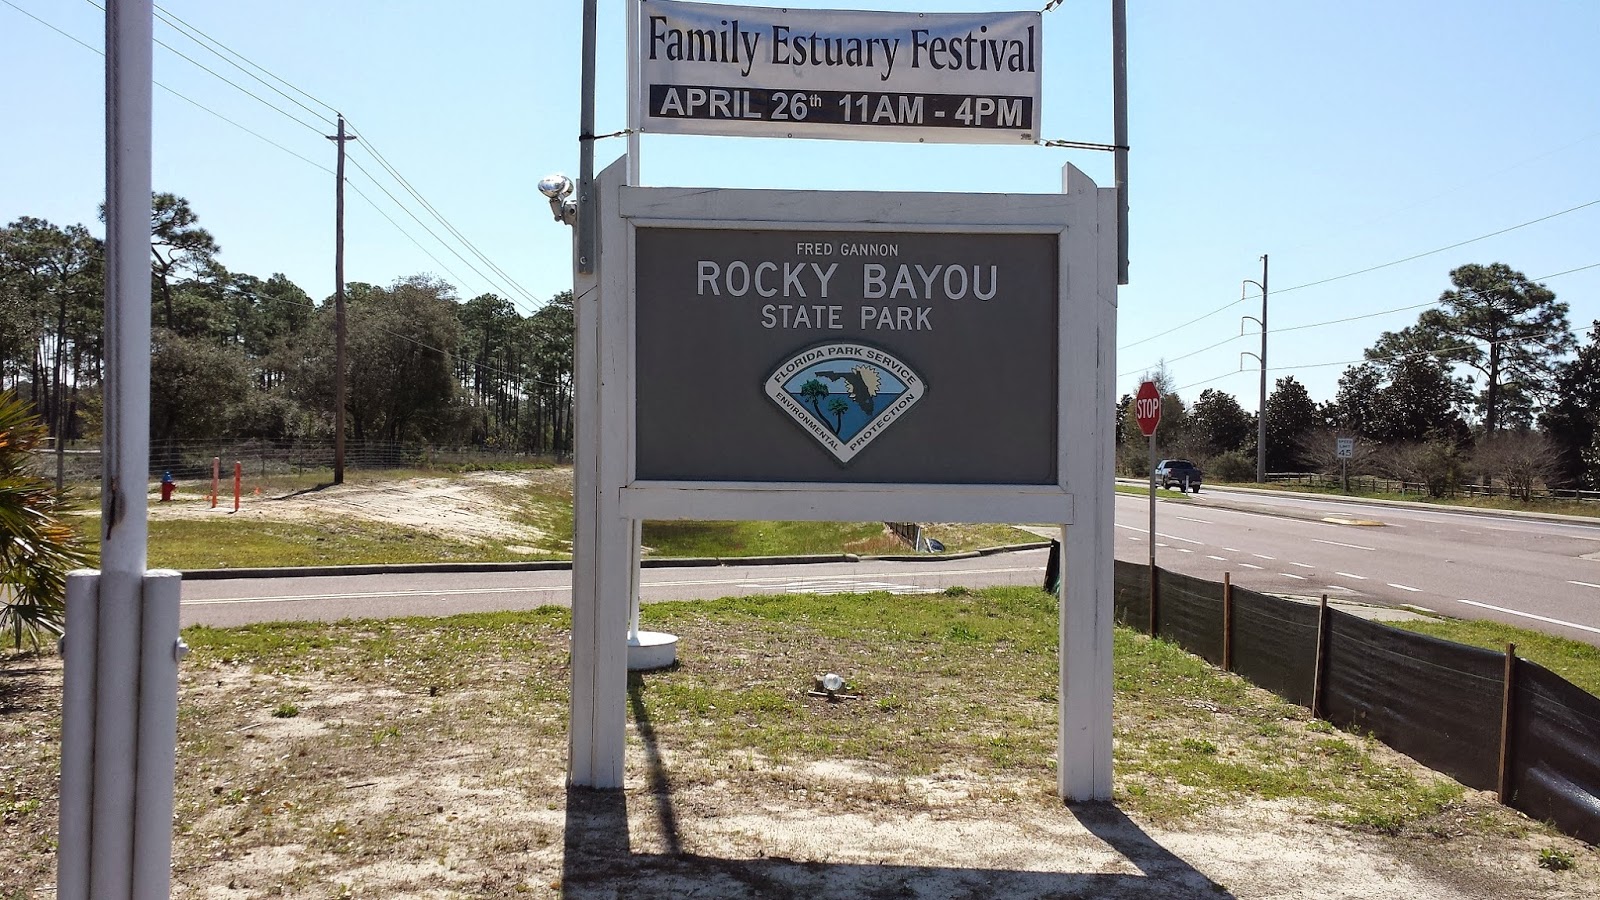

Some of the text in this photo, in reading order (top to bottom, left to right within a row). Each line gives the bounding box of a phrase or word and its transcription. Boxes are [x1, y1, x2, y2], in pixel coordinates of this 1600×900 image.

[649, 16, 1035, 81] Family Estuary Festival
[660, 87, 1023, 127] APRIL 26th 11AM - 4PM
[797, 243, 899, 257] FRED GANNON
[697, 260, 997, 301] ROCKY BAYOU
[761, 304, 932, 331] STATE PARK
[774, 346, 916, 386] FLORIDA PARK SERVICE
[775, 392, 839, 451] ENVIRONMENTAL
[850, 393, 915, 451] PROTECTION
[1137, 398, 1158, 419] STOP
